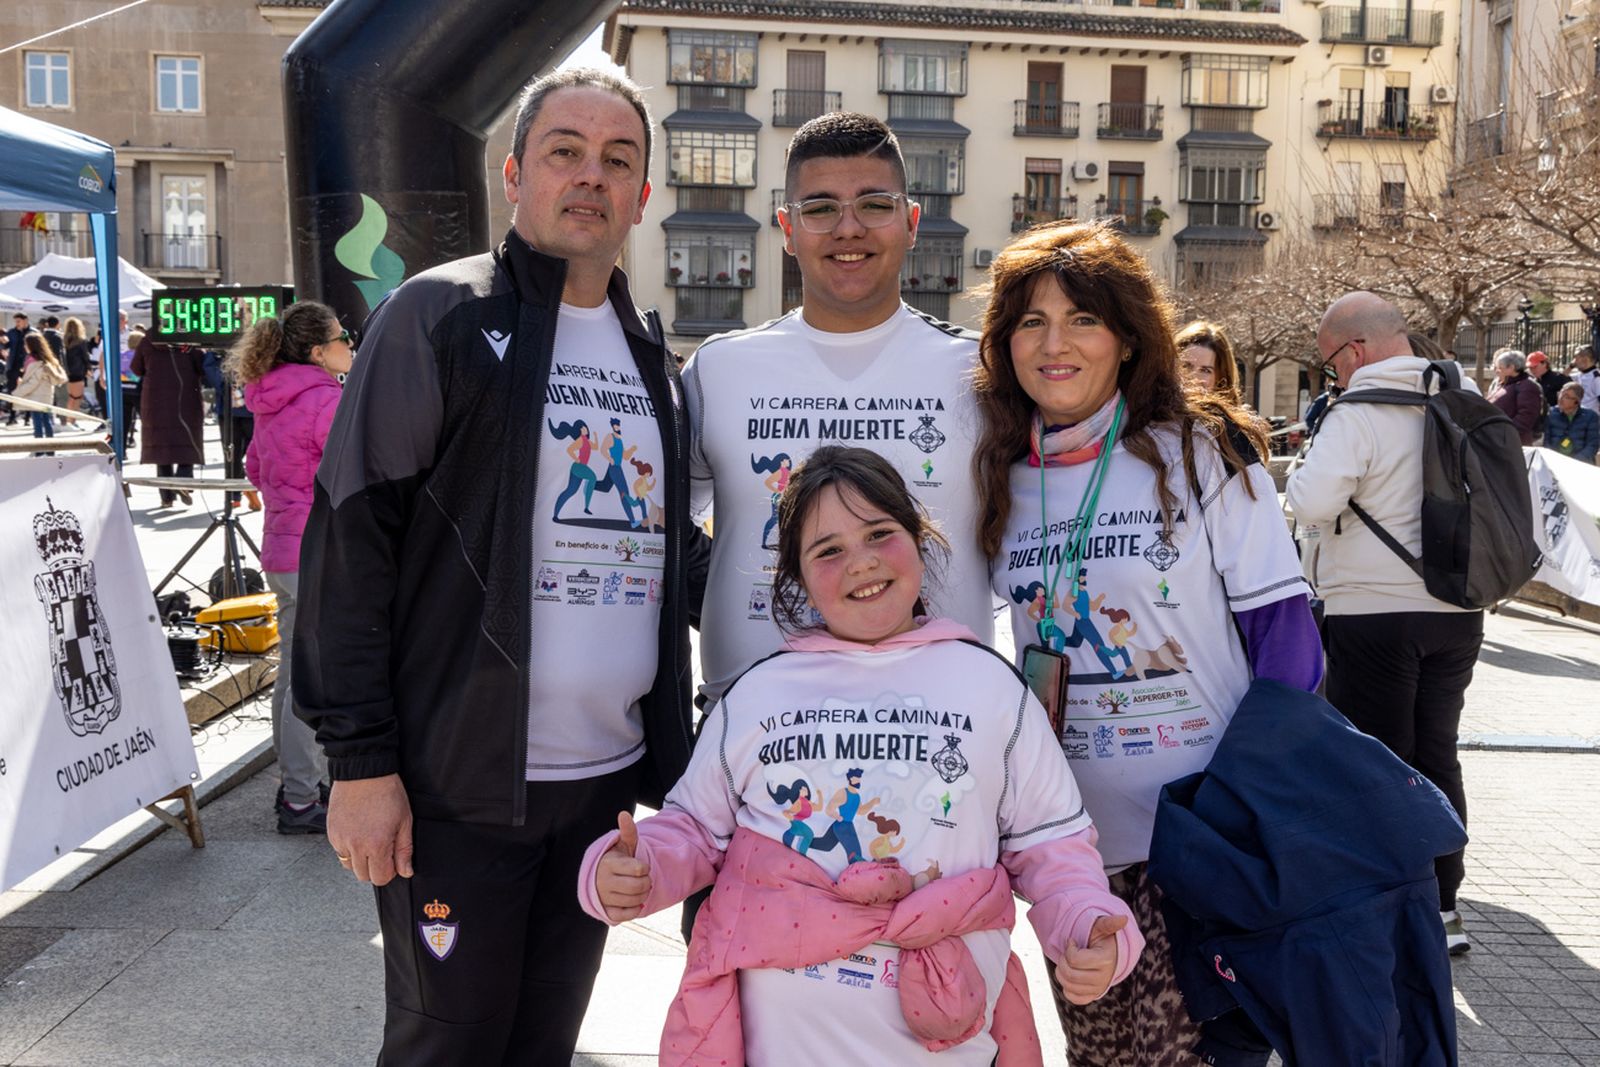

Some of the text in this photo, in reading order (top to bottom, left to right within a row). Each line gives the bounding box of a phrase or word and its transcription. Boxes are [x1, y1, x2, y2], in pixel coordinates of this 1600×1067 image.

[593, 389, 657, 418] MUERTE
[750, 397, 945, 411] VI CARRERA CAMINATA
[748, 418, 905, 440] BUENA MUERTE
[568, 541, 599, 551] beneficio
[1017, 531, 1028, 543] VI
[1008, 544, 1061, 571] BUENA
[567, 587, 597, 596] BYD
[1132, 689, 1189, 704] ASPERGER-TEA
[760, 708, 973, 733] VI CARRERA CAMINATA
[56, 726, 156, 793] CIUDAD DE JAÉN
[758, 733, 928, 765] BUENA MUERTE
